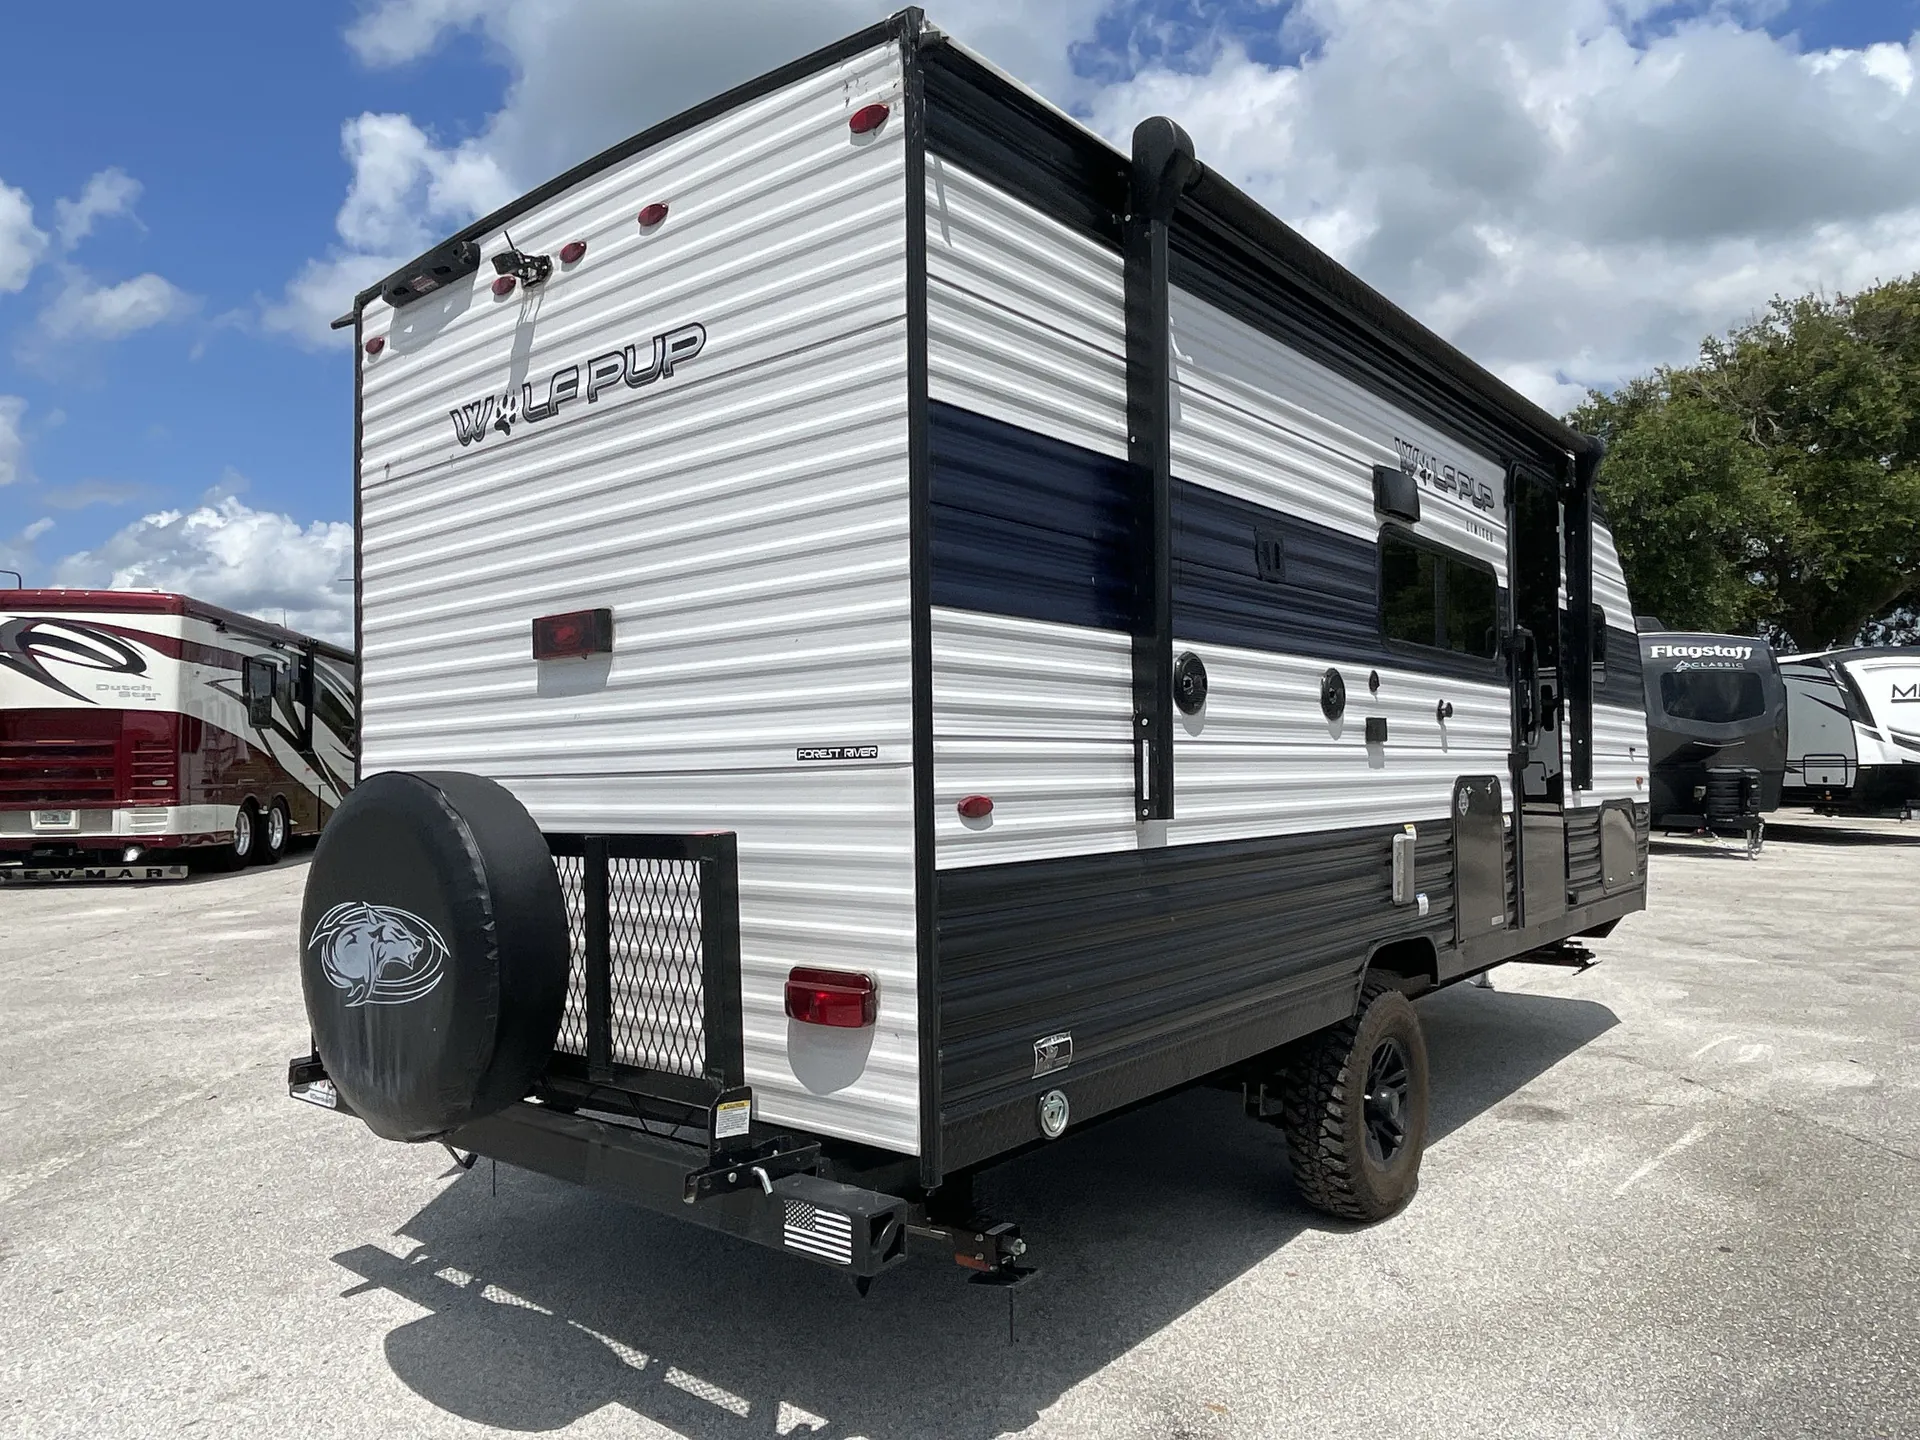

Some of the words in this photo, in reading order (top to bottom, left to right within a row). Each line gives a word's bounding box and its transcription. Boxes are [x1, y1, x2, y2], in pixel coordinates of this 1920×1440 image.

[587, 321, 707, 404] PUP
[1650, 645, 1753, 660] Flagstaff
[1691, 661, 1744, 669] CLASSIC
[95, 684, 152, 692] Dutch
[798, 748, 841, 759] FOREST
[844, 747, 877, 757] RIVER
[0, 868, 163, 880] NEWMAR
